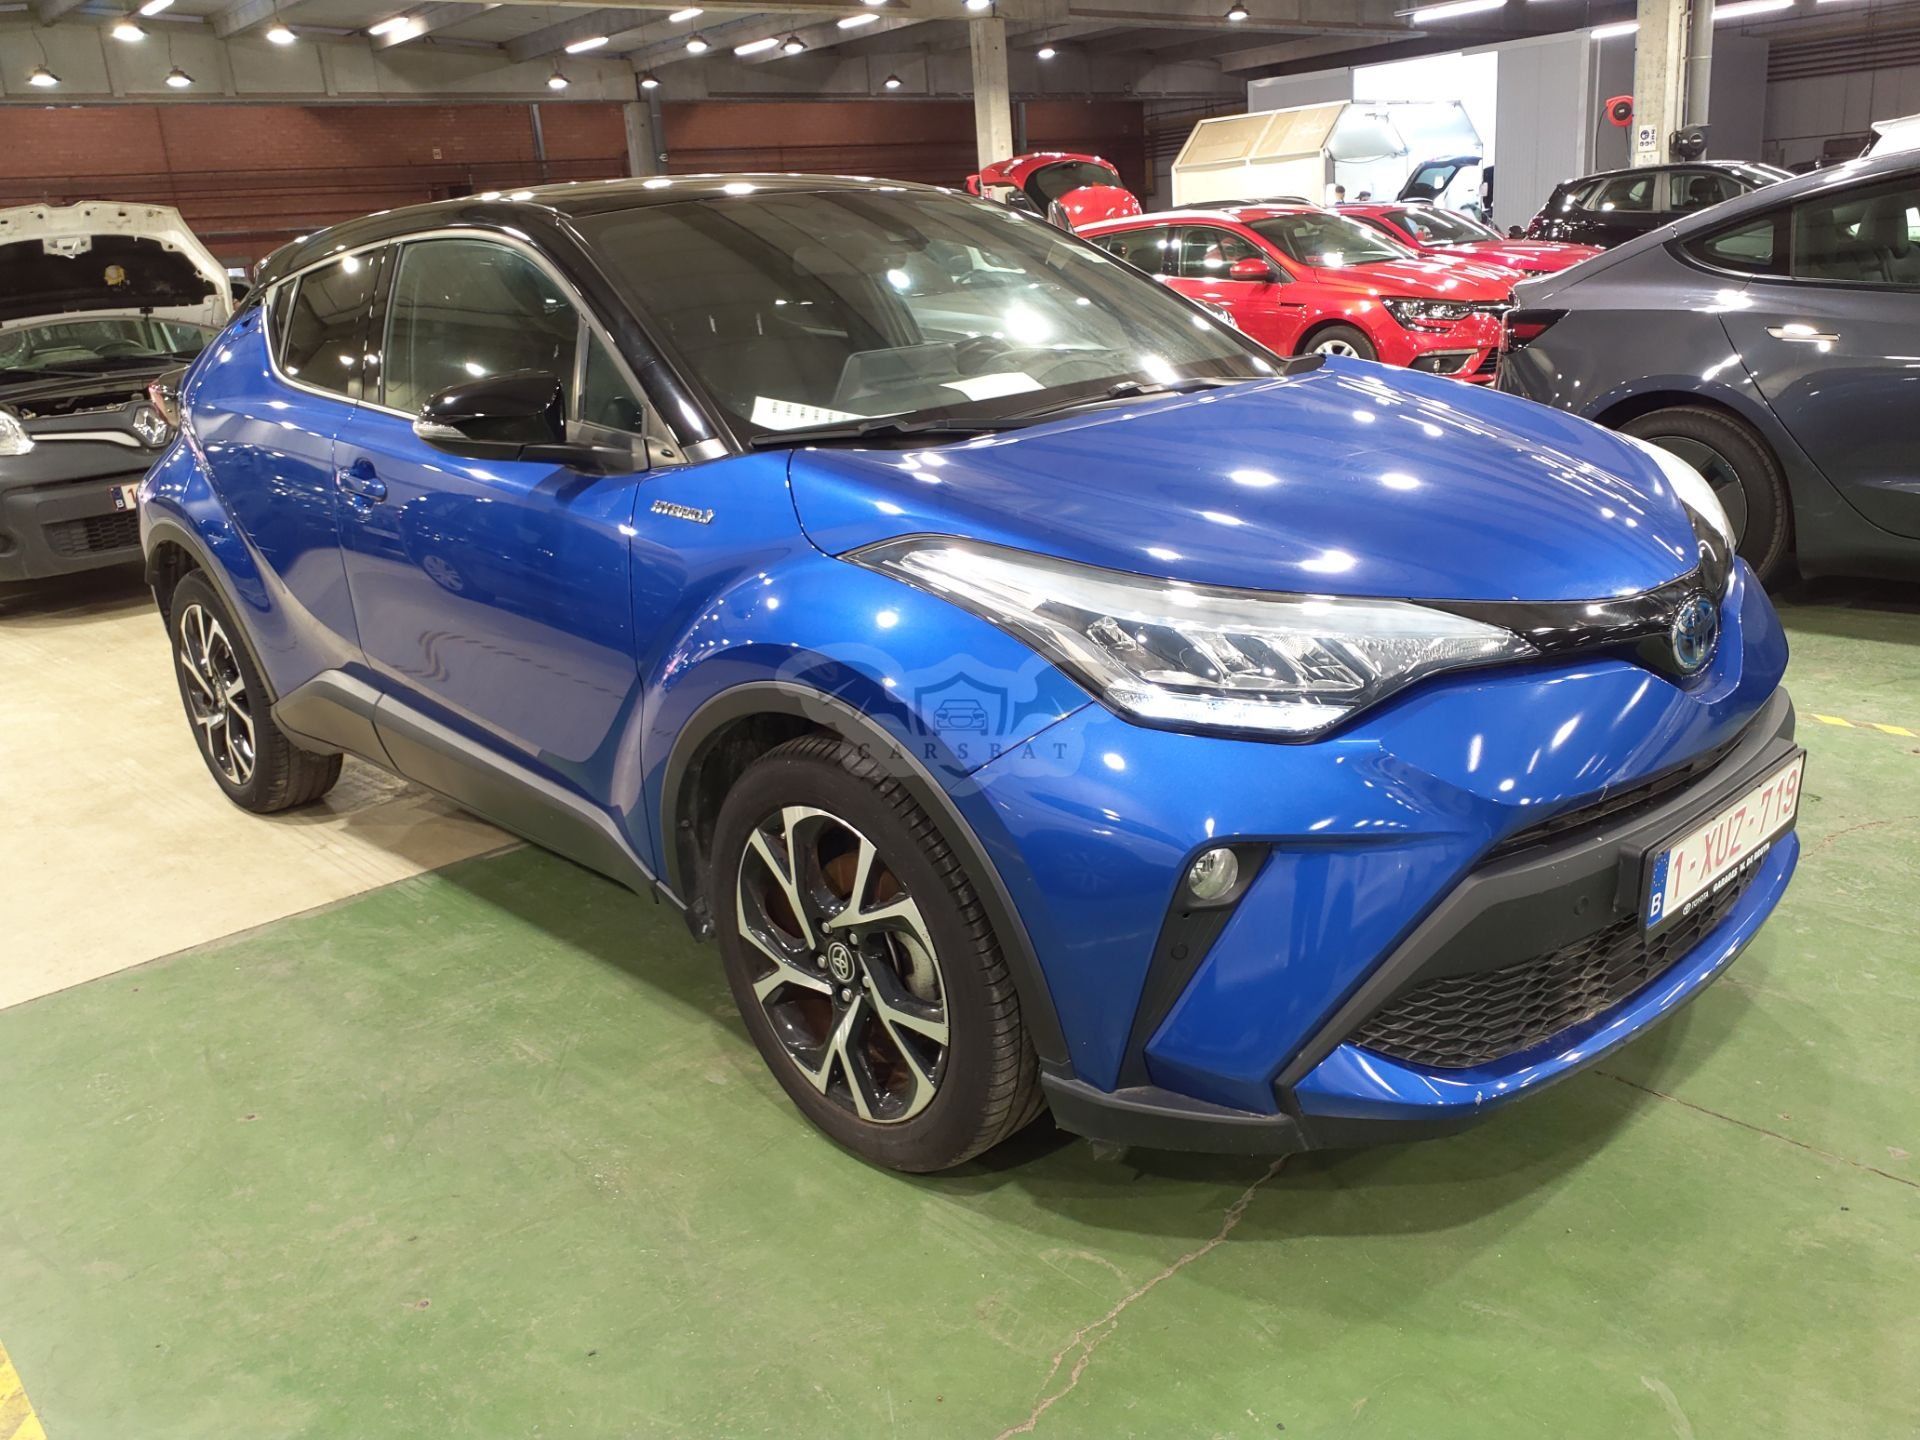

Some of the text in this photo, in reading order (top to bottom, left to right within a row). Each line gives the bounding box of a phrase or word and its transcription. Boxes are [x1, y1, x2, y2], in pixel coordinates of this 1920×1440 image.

[1650, 768, 1798, 918] B 1-XUZ-719
[1691, 890, 1709, 909] TOYOTA
